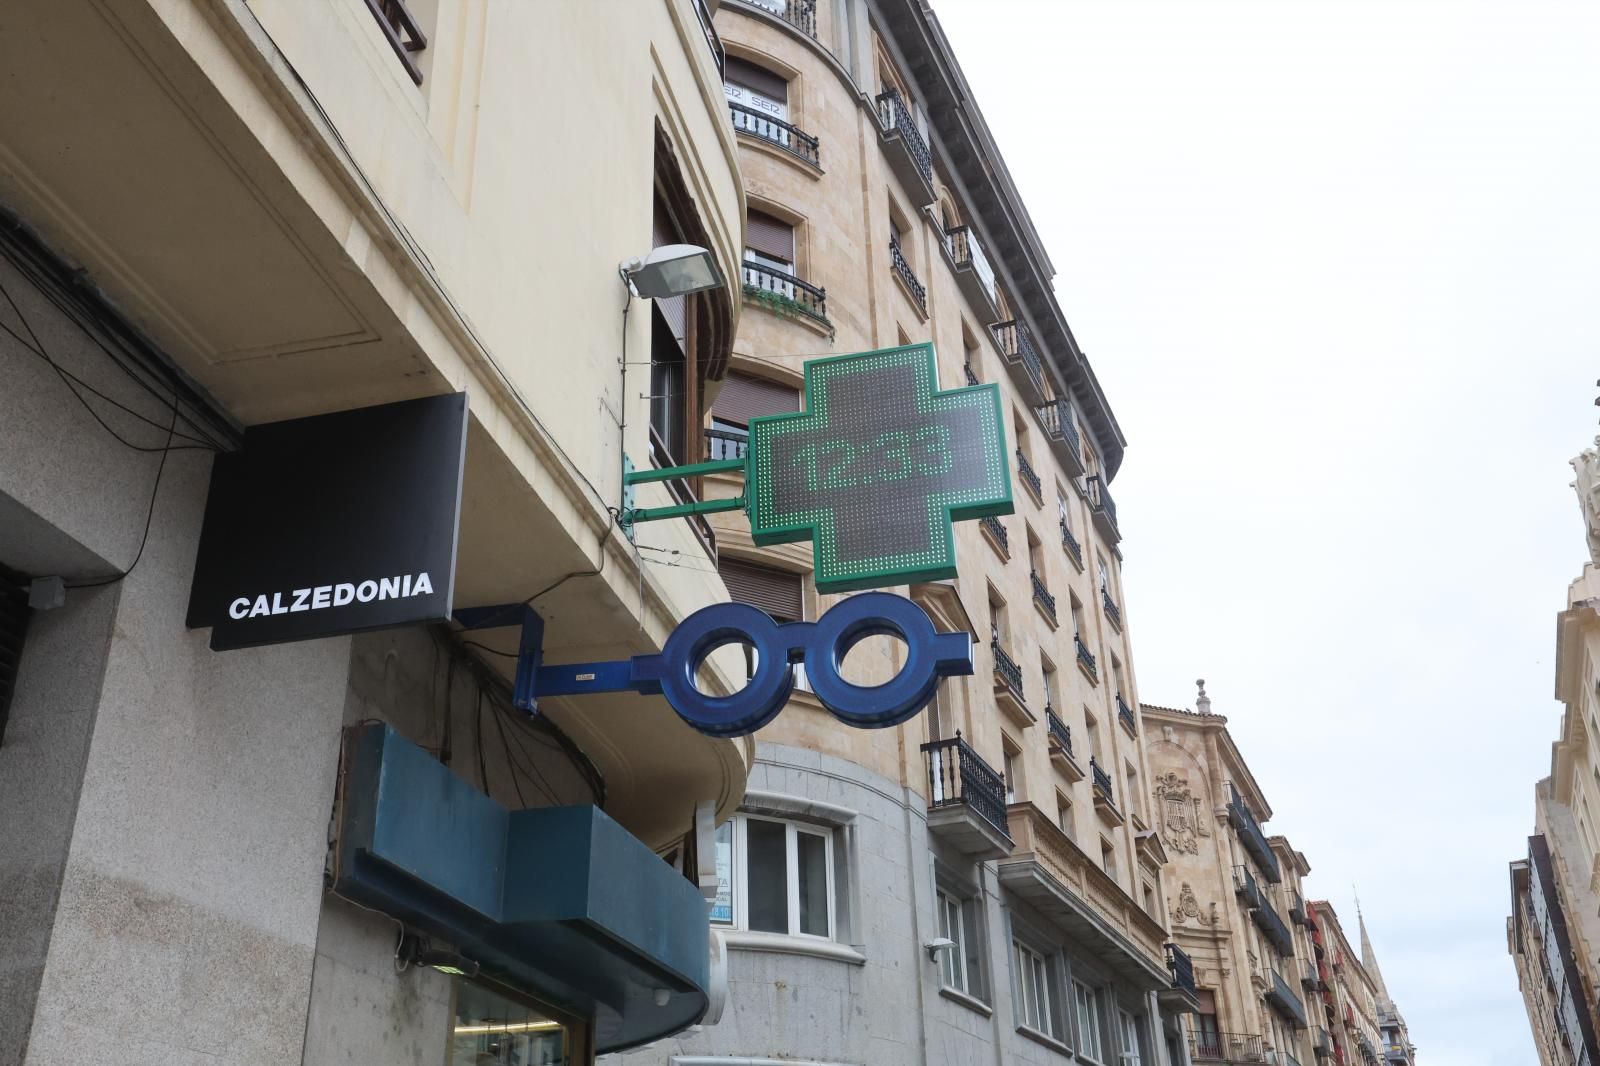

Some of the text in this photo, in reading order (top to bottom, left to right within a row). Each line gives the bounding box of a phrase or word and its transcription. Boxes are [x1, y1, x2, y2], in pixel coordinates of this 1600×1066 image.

[751, 96, 780, 115] SER
[791, 425, 952, 491] 12:33
[229, 572, 434, 620] CALZEDONIA
